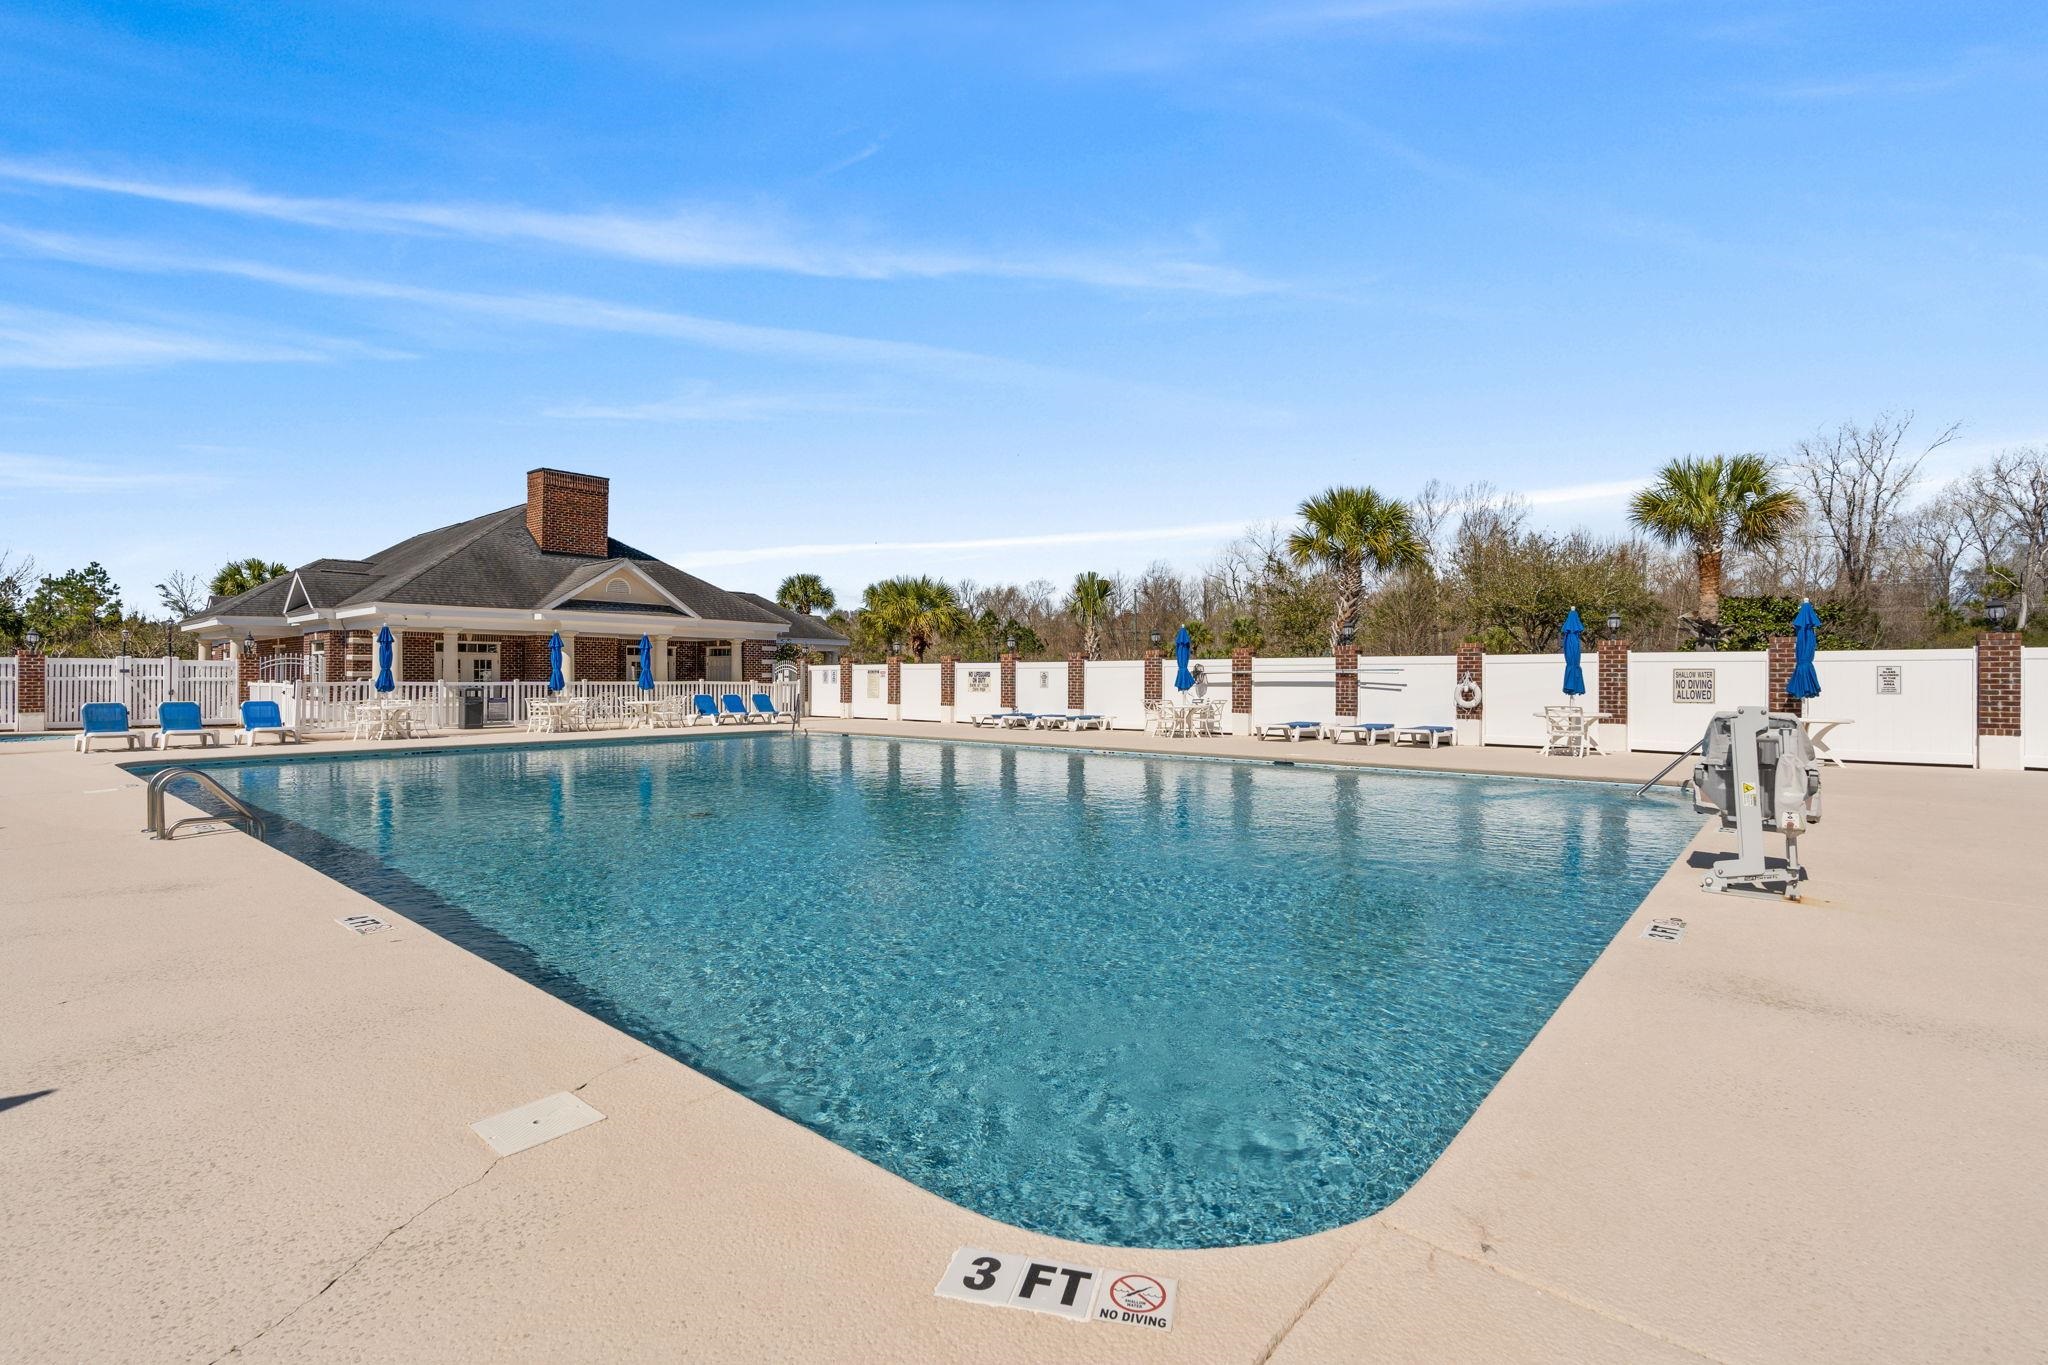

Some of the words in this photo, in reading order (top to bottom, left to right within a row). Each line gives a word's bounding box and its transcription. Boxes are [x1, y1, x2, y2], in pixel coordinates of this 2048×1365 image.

[1675, 671, 1696, 679] SHALLOW
[1697, 671, 1712, 679] WATER
[1675, 679, 1686, 690] NO
[1687, 679, 1713, 690] DIVING
[1676, 690, 1712, 700] ALLOWED
[962, 1256, 1002, 1291] 3
[1018, 1263, 1092, 1306] FT
[1124, 1298, 1147, 1306] SHALLOW
[1099, 1308, 1119, 1320] NO
[1122, 1311, 1167, 1328] DIVING
